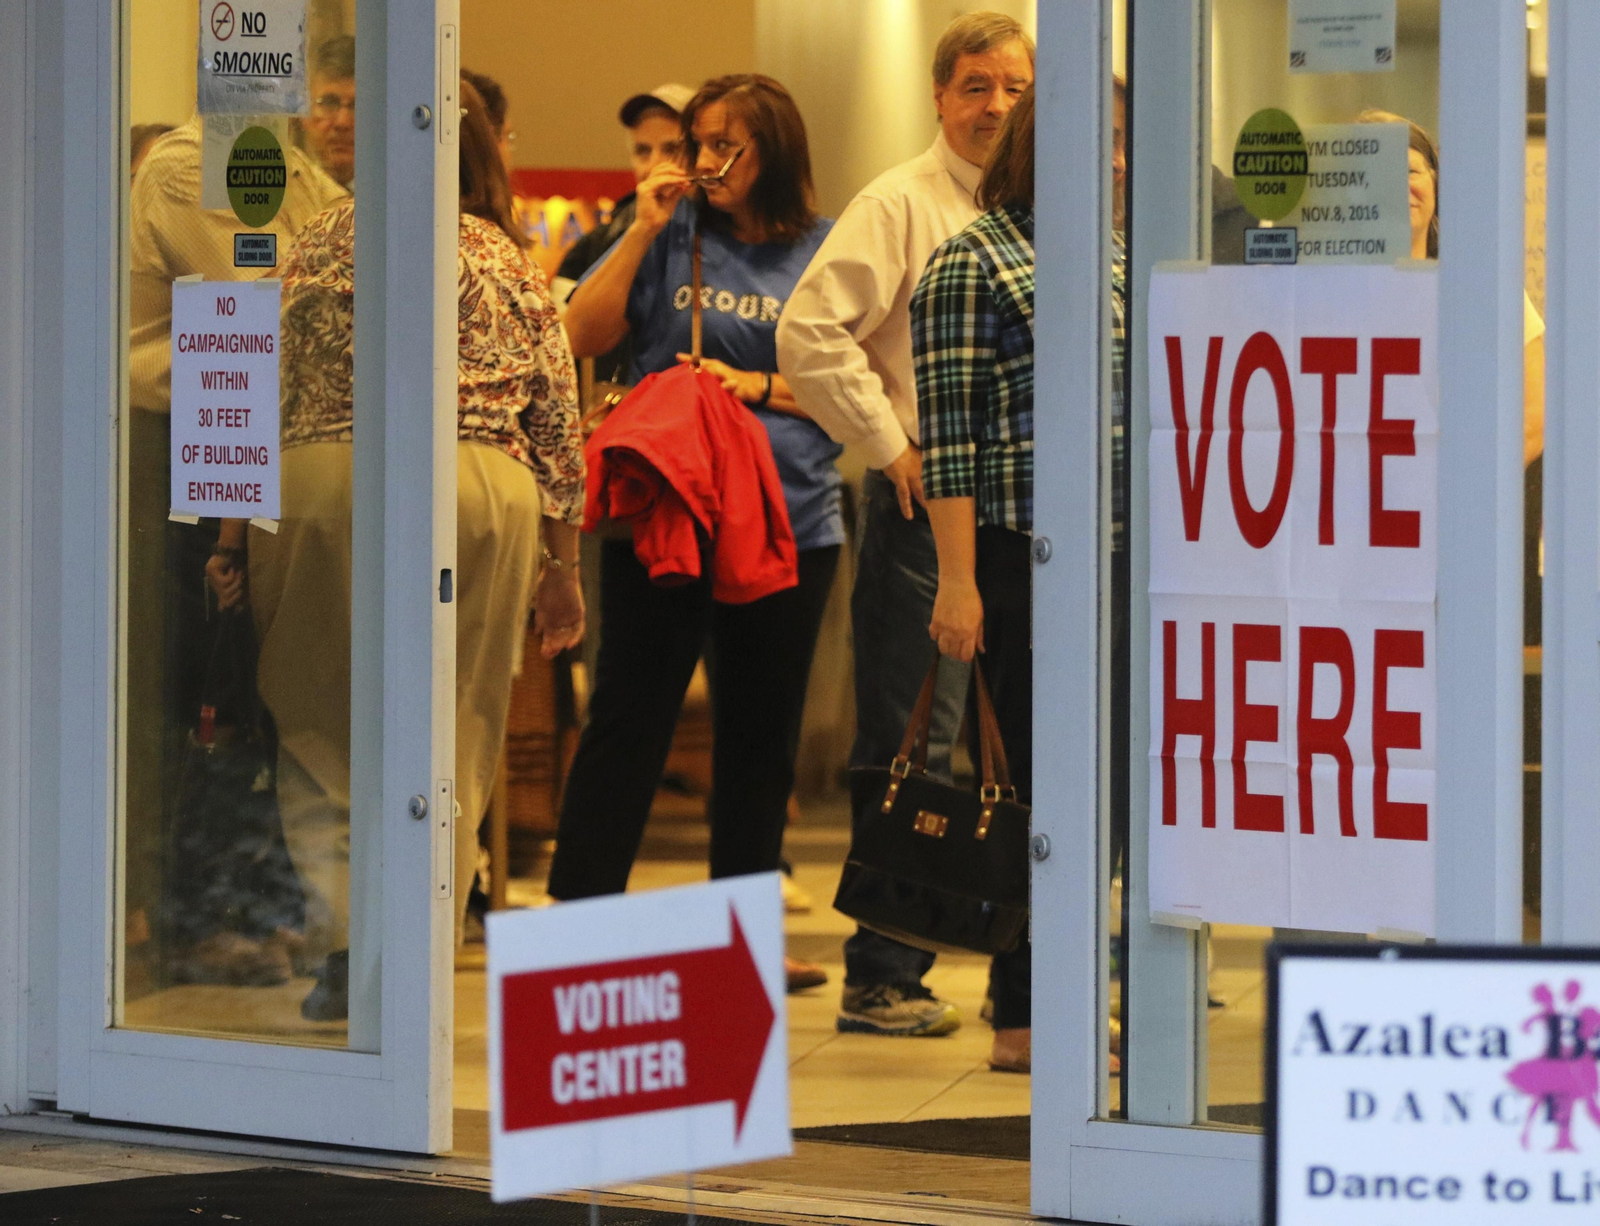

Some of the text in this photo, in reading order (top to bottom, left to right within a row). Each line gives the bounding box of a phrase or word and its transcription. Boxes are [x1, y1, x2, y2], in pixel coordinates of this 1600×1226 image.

[242, 12, 267, 36] NO
[212, 51, 293, 76] SMOKING
[1240, 132, 1302, 146] AUTOMATIC
[1307, 140, 1379, 156] YM CLOSED
[233, 149, 281, 160] AUTOMATIC
[1236, 155, 1306, 173] CAUTION
[229, 168, 284, 185] CAUTION
[1308, 171, 1369, 188] TUESDAY,
[244, 193, 269, 204] DOOR
[1255, 182, 1286, 195] DOOR
[1301, 205, 1379, 223] NOV.8, 2016
[241, 239, 269, 250] AUTOMATIC
[1298, 240, 1386, 256] FOR ELECTION
[216, 296, 236, 316] NO
[178, 333, 274, 354] CAMPAIGNING
[201, 371, 248, 390] WITHIN
[198, 408, 251, 428] 30 FEET
[1164, 331, 1420, 549] VOTE
[182, 444, 268, 466] OF BUILDING
[188, 482, 262, 503] ENTRANCE
[1162, 620, 1428, 841] HERE
[553, 970, 680, 1035] VOTING
[1293, 1007, 1510, 1058] Azalea
[551, 1039, 686, 1105] CENTER
[1307, 1165, 1600, 1203] Dance to Li
